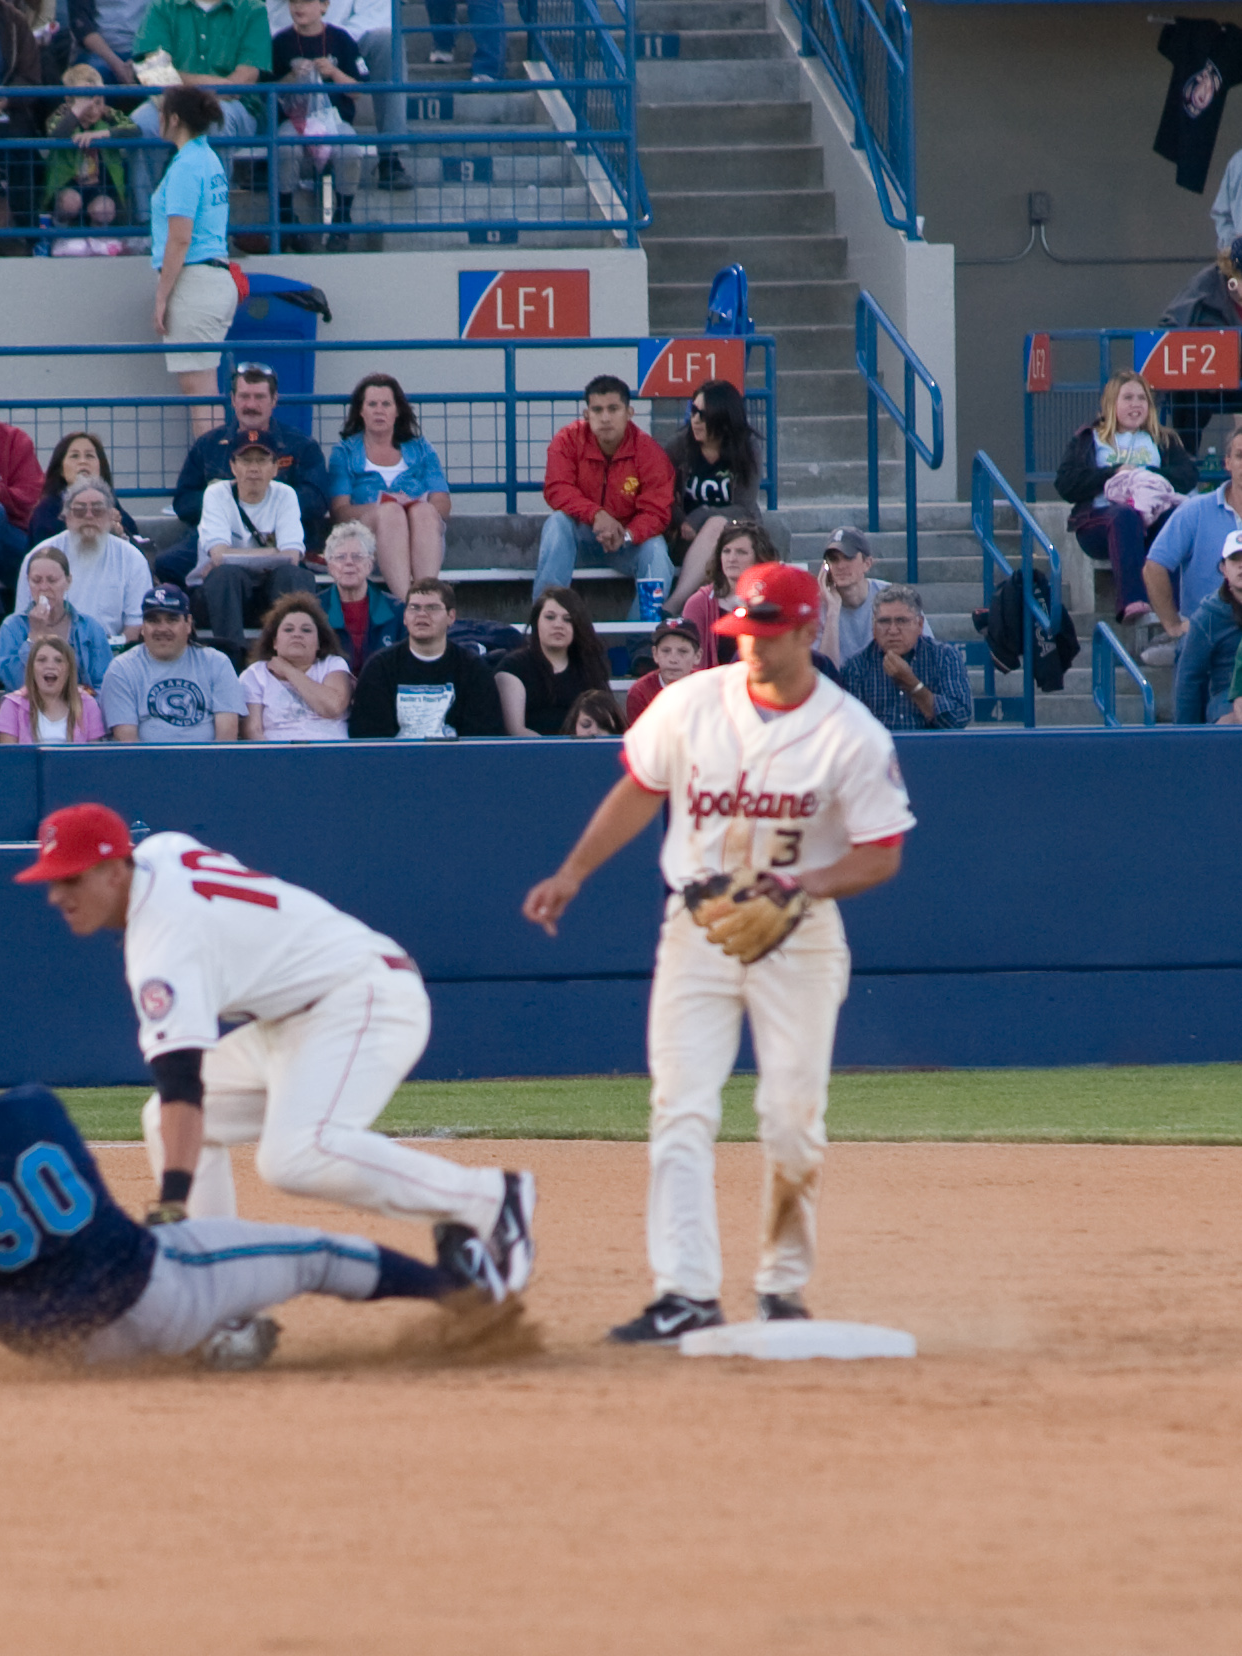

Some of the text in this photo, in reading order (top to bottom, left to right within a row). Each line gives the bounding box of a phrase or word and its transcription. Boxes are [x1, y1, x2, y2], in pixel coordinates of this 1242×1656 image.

[644, 36, 663, 57] 11
[418, 98, 441, 120] 10
[496, 286, 555, 330] LF1
[668, 352, 716, 383] LF1
[1031, 347, 1046, 379] LF2
[1163, 344, 1216, 375] LF2
[991, 699, 1004, 721] 4
[770, 829, 803, 867] 3
